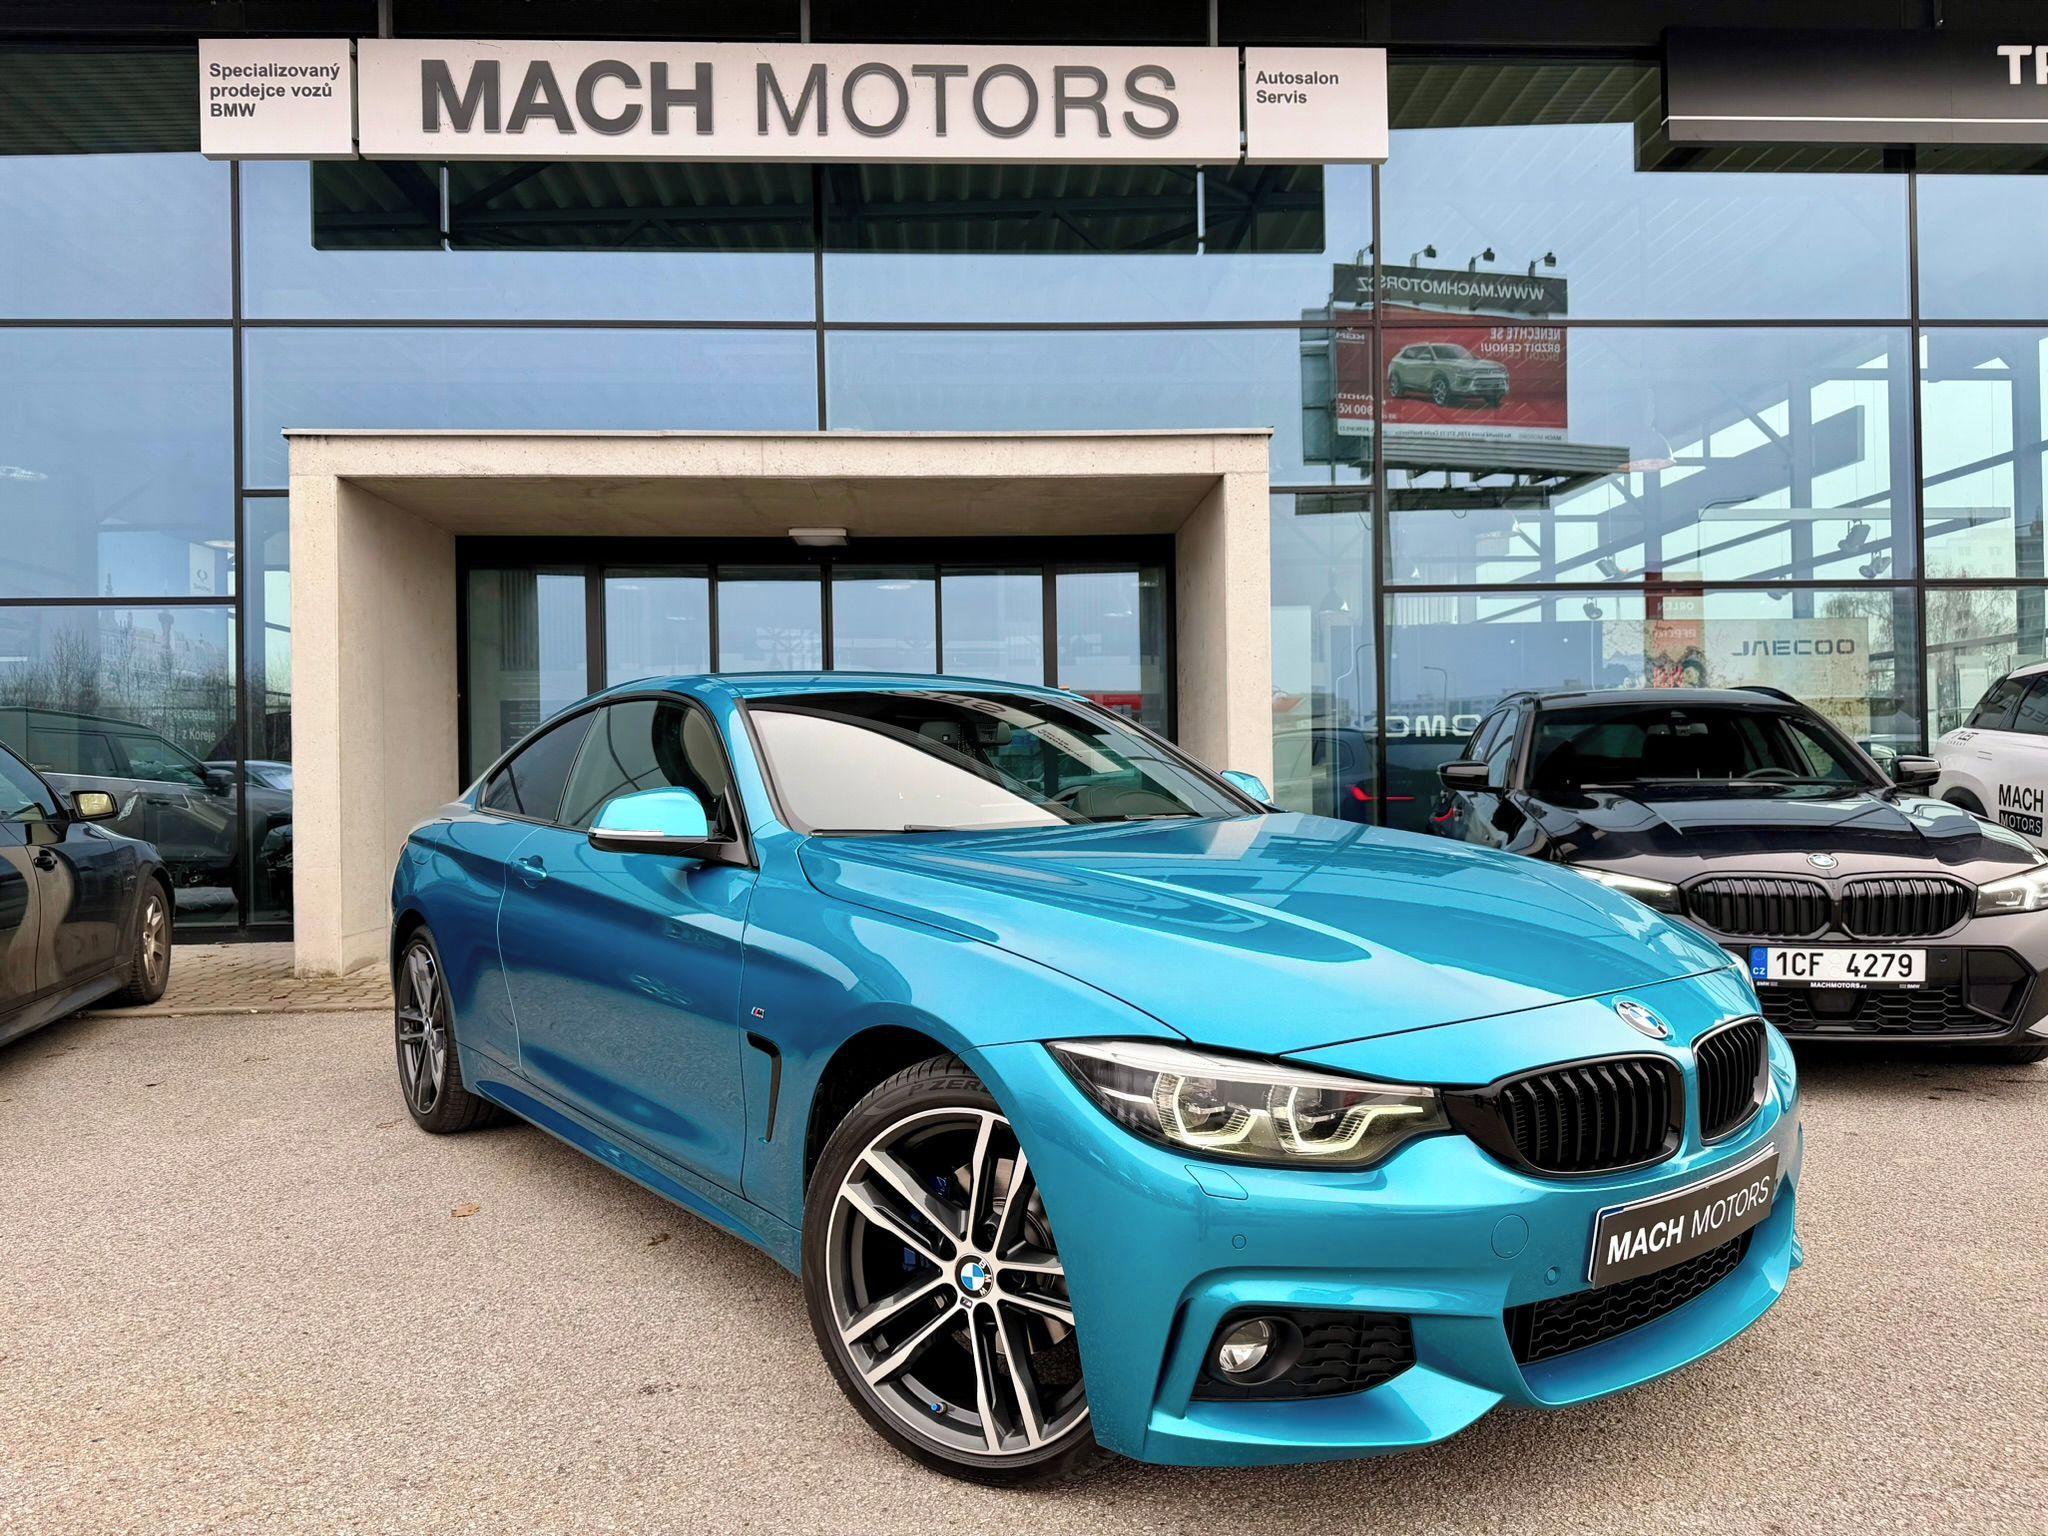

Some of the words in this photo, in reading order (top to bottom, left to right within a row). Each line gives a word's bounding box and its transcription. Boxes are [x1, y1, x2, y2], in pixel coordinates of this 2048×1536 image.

[209, 63, 340, 81] Specializovaný
[1256, 71, 1339, 85] Autosalon
[210, 83, 286, 101] prodejce
[291, 82, 333, 98] vozů
[421, 59, 714, 136] MACH
[755, 61, 1180, 138] MOTORS
[1256, 90, 1308, 104] Servis
[210, 103, 256, 117] BMW
[1731, 639, 1855, 656] JAECOO
[1999, 784, 2044, 813] MACH
[2000, 812, 2042, 834] MOTORS
[1752, 966, 1766, 976] CZ
[1776, 951, 1824, 977] 1CF
[1846, 953, 1913, 978] 4279
[1606, 1215, 1685, 1265] MACH
[1690, 1175, 1771, 1239] MOTORS
